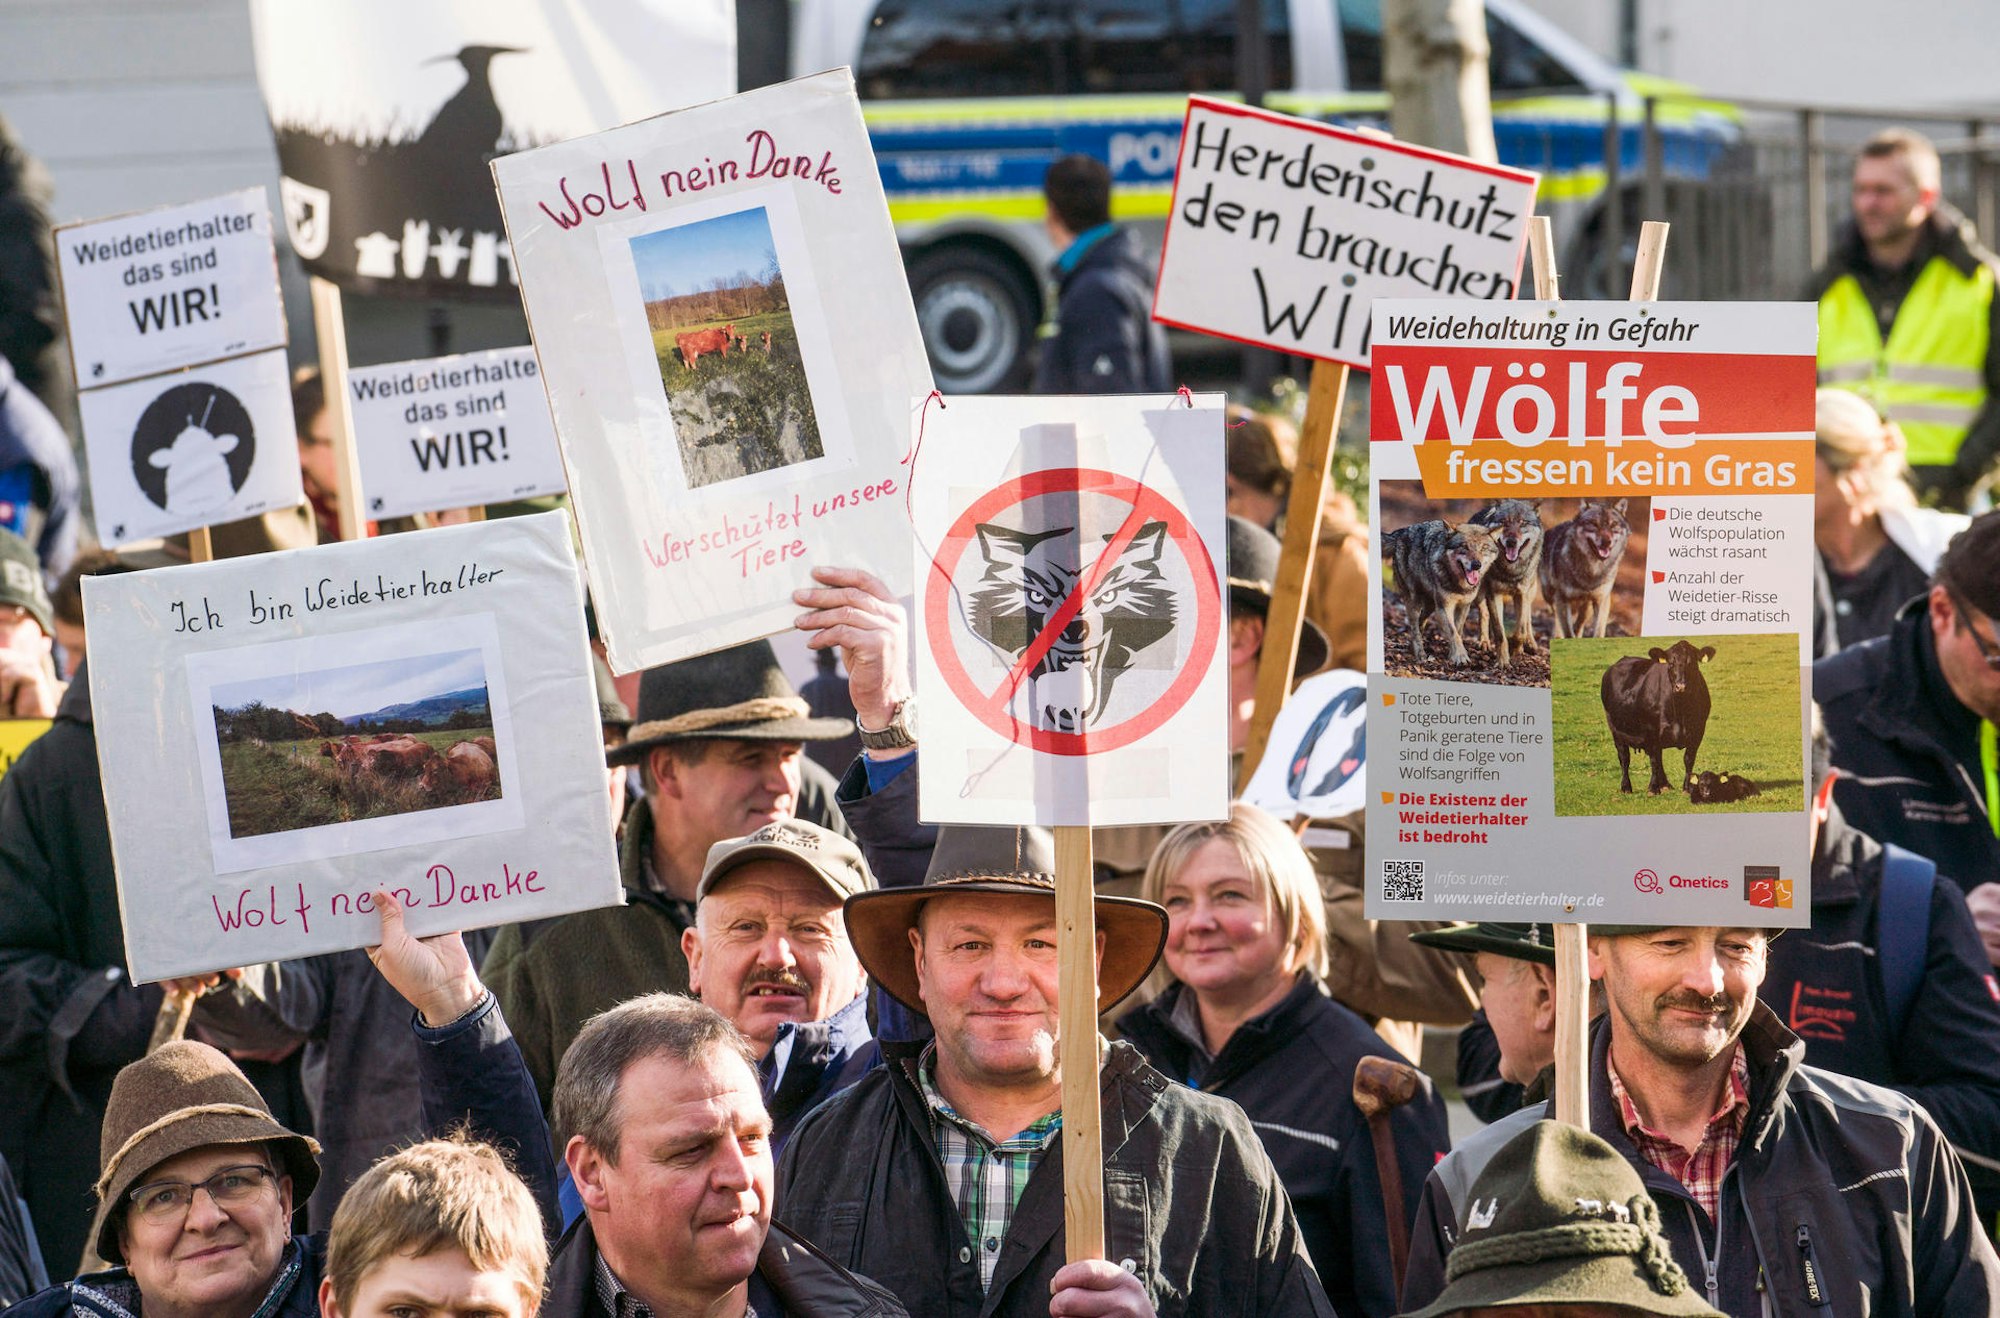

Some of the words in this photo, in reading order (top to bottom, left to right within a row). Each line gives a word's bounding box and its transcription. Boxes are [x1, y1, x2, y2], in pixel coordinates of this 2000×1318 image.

[538, 160, 647, 230] Wolf
[660, 158, 739, 197] nein
[745, 129, 842, 195] Danke
[1192, 121, 1517, 242] Herdenschutz
[73, 212, 255, 266] Weidetierhalter
[1183, 182, 1280, 243] den
[1297, 206, 1513, 300] brauchen
[123, 263, 164, 286] das
[170, 247, 218, 277] sind
[128, 283, 222, 335] WIR!
[1388, 315, 1569, 347] Weidehaltung
[1575, 316, 1599, 341] in
[1607, 317, 1700, 348] Gefahr
[353, 358, 538, 401] Weidetierhalte
[405, 402, 449, 424] das
[455, 390, 507, 417] sind
[1384, 361, 1701, 449] Wölfe
[410, 425, 511, 473] WIR!
[1445, 450, 1593, 485] fressen
[1605, 453, 1691, 487] kein
[1704, 454, 1797, 488] Gras
[812, 478, 898, 518] unsere
[1670, 507, 1693, 521] Die
[1697, 508, 1763, 521] deutsche
[1669, 526, 1785, 542] Wolfspopulation
[731, 538, 808, 577] Tiere
[1668, 545, 1718, 559] wächst
[1722, 546, 1767, 559] rasant
[1668, 571, 1716, 584] Anzahl
[1720, 571, 1745, 585] der
[171, 597, 224, 633] Ich
[250, 590, 294, 625] bin
[305, 563, 503, 611] Weidetierhalter
[1668, 590, 1778, 604] Weidetier-Risse
[1668, 609, 1706, 625] steigt
[1710, 609, 1790, 623] dramatisch
[1400, 692, 1431, 706] Tote
[1435, 692, 1473, 707] Tiere,
[1400, 711, 1487, 727] Totgeburten
[1491, 713, 1518, 725] und
[1523, 713, 1535, 725] in
[1400, 729, 1438, 743] Panik
[1441, 732, 1504, 746] geratene
[1508, 731, 1543, 744] Tiere
[1399, 748, 1428, 762] sind
[1432, 748, 1454, 762] die
[1458, 749, 1496, 765] Folge
[1499, 751, 1525, 763] von
[1400, 766, 1500, 783] Wolfsangriffen
[1399, 792, 1425, 805] Die
[1429, 793, 1496, 807] Existenz
[1500, 794, 1528, 807] der
[1399, 811, 1528, 826] Weidetierhalter
[1399, 829, 1420, 842] ist
[1423, 830, 1489, 844] bedroht
[331, 883, 422, 916] nen
[427, 864, 546, 909] Danke
[1434, 870, 1467, 889] Infos
[1470, 873, 1509, 886] unter:
[1669, 875, 1729, 889] Qnetics
[1434, 891, 1605, 907] www.weidetierhalter.de
[1805, 1260, 1821, 1302] GORE-TEX
